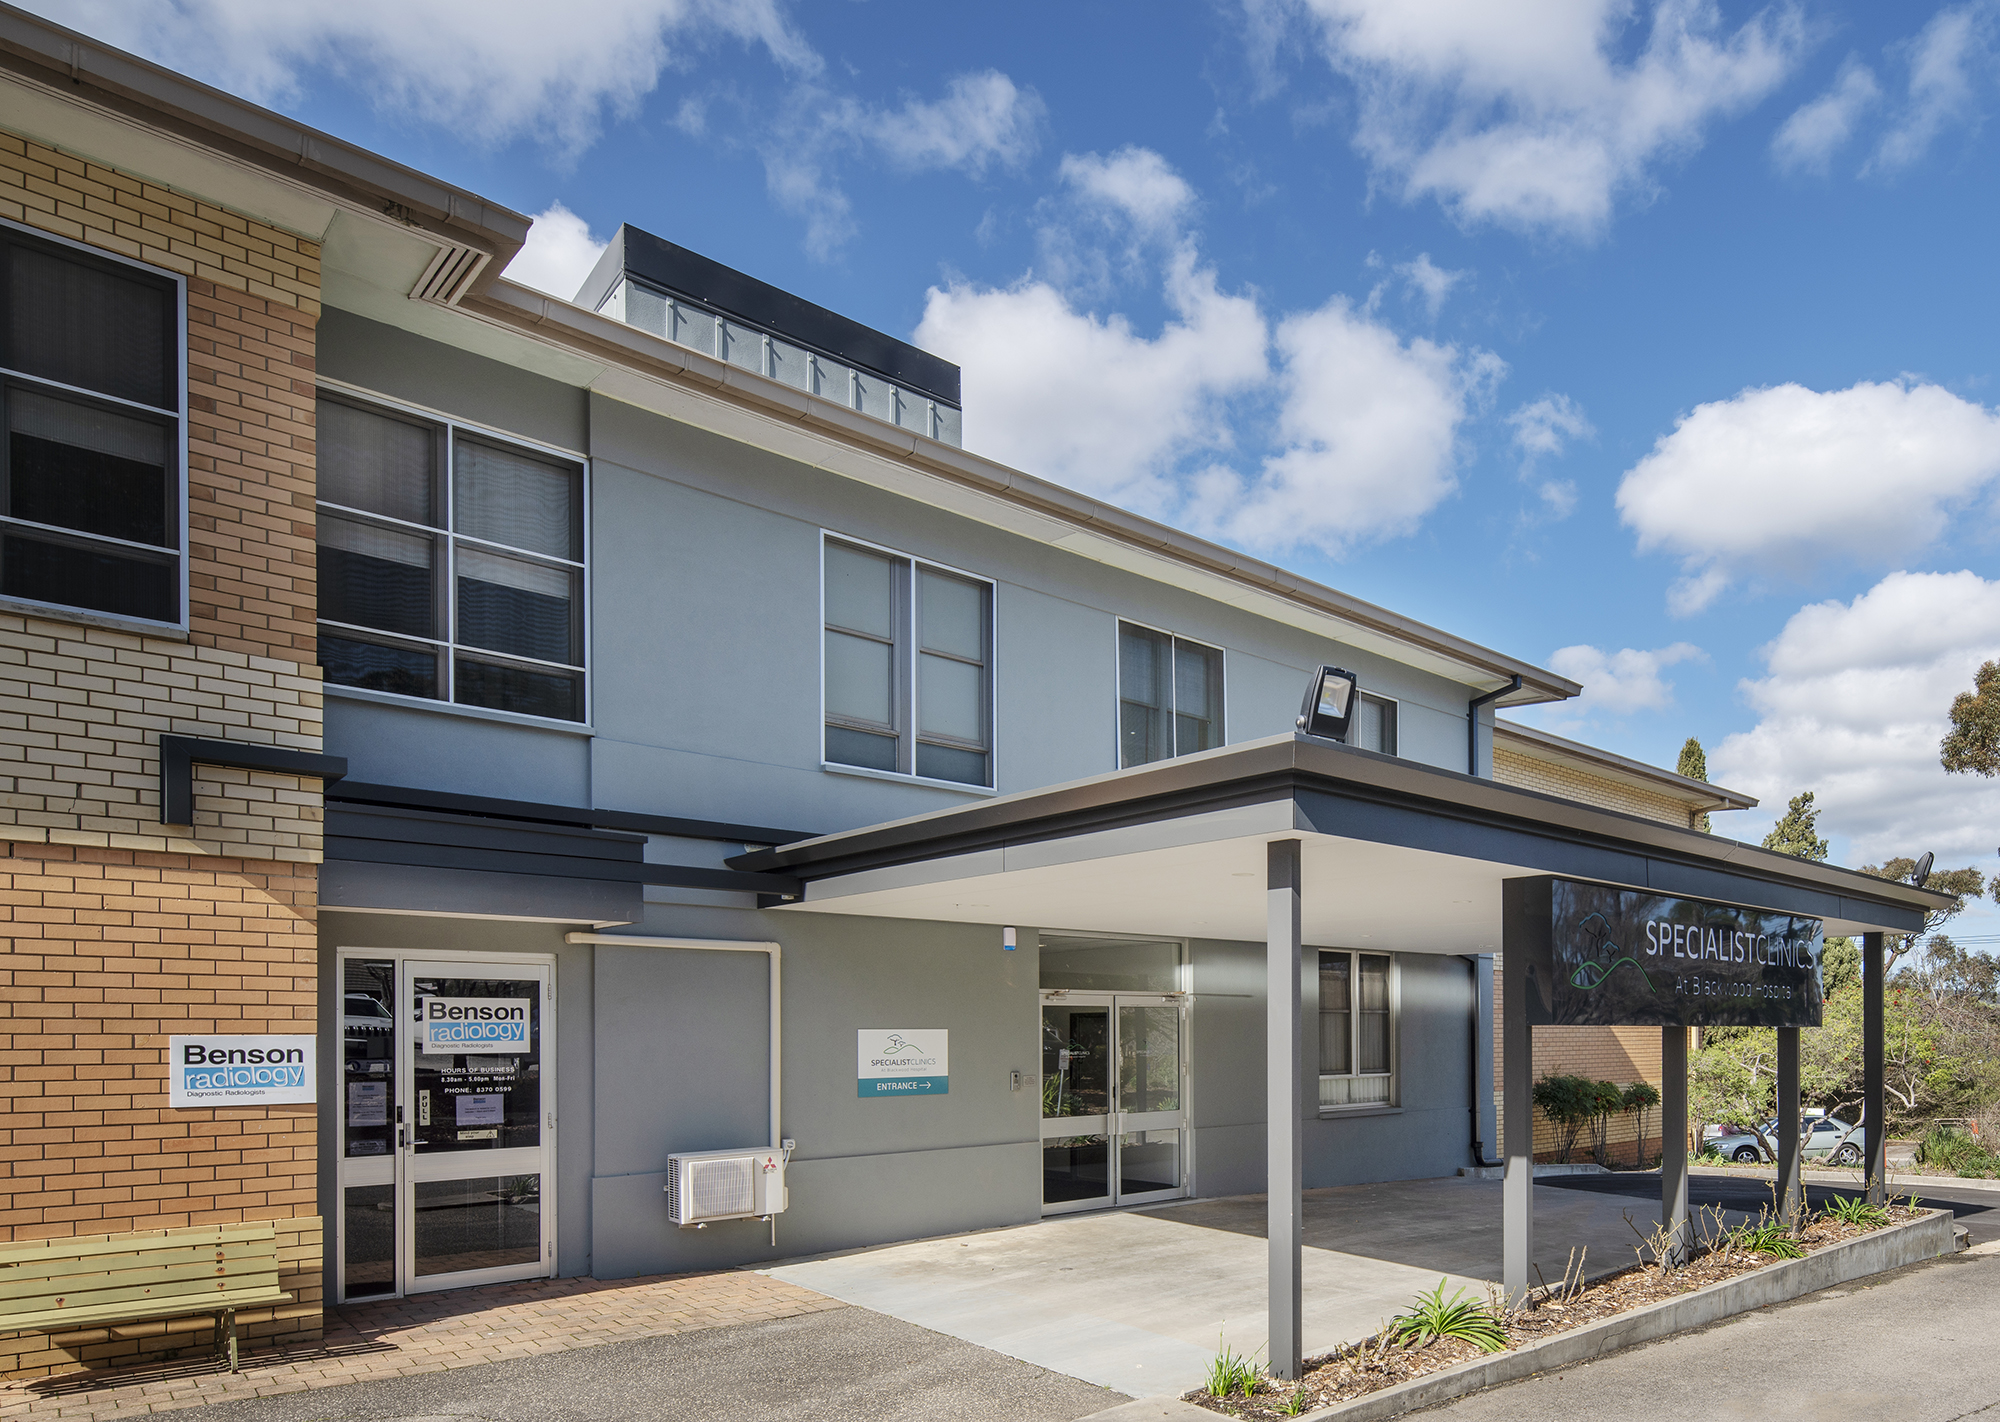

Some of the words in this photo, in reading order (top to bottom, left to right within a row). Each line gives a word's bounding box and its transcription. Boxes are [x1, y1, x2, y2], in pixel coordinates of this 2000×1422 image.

[1645, 919, 1814, 970] SPECIALISTCLINICS
[1675, 976, 1688, 995] At
[429, 1001, 524, 1021] Benson
[430, 1022, 523, 1041] radiology
[183, 1044, 304, 1065] Benson
[870, 1058, 937, 1067] SPECIALISTCLINICS
[186, 1066, 303, 1089] radiology
[876, 1082, 918, 1091] ENTRANCE
[225, 1089, 266, 1097] Radiologists
